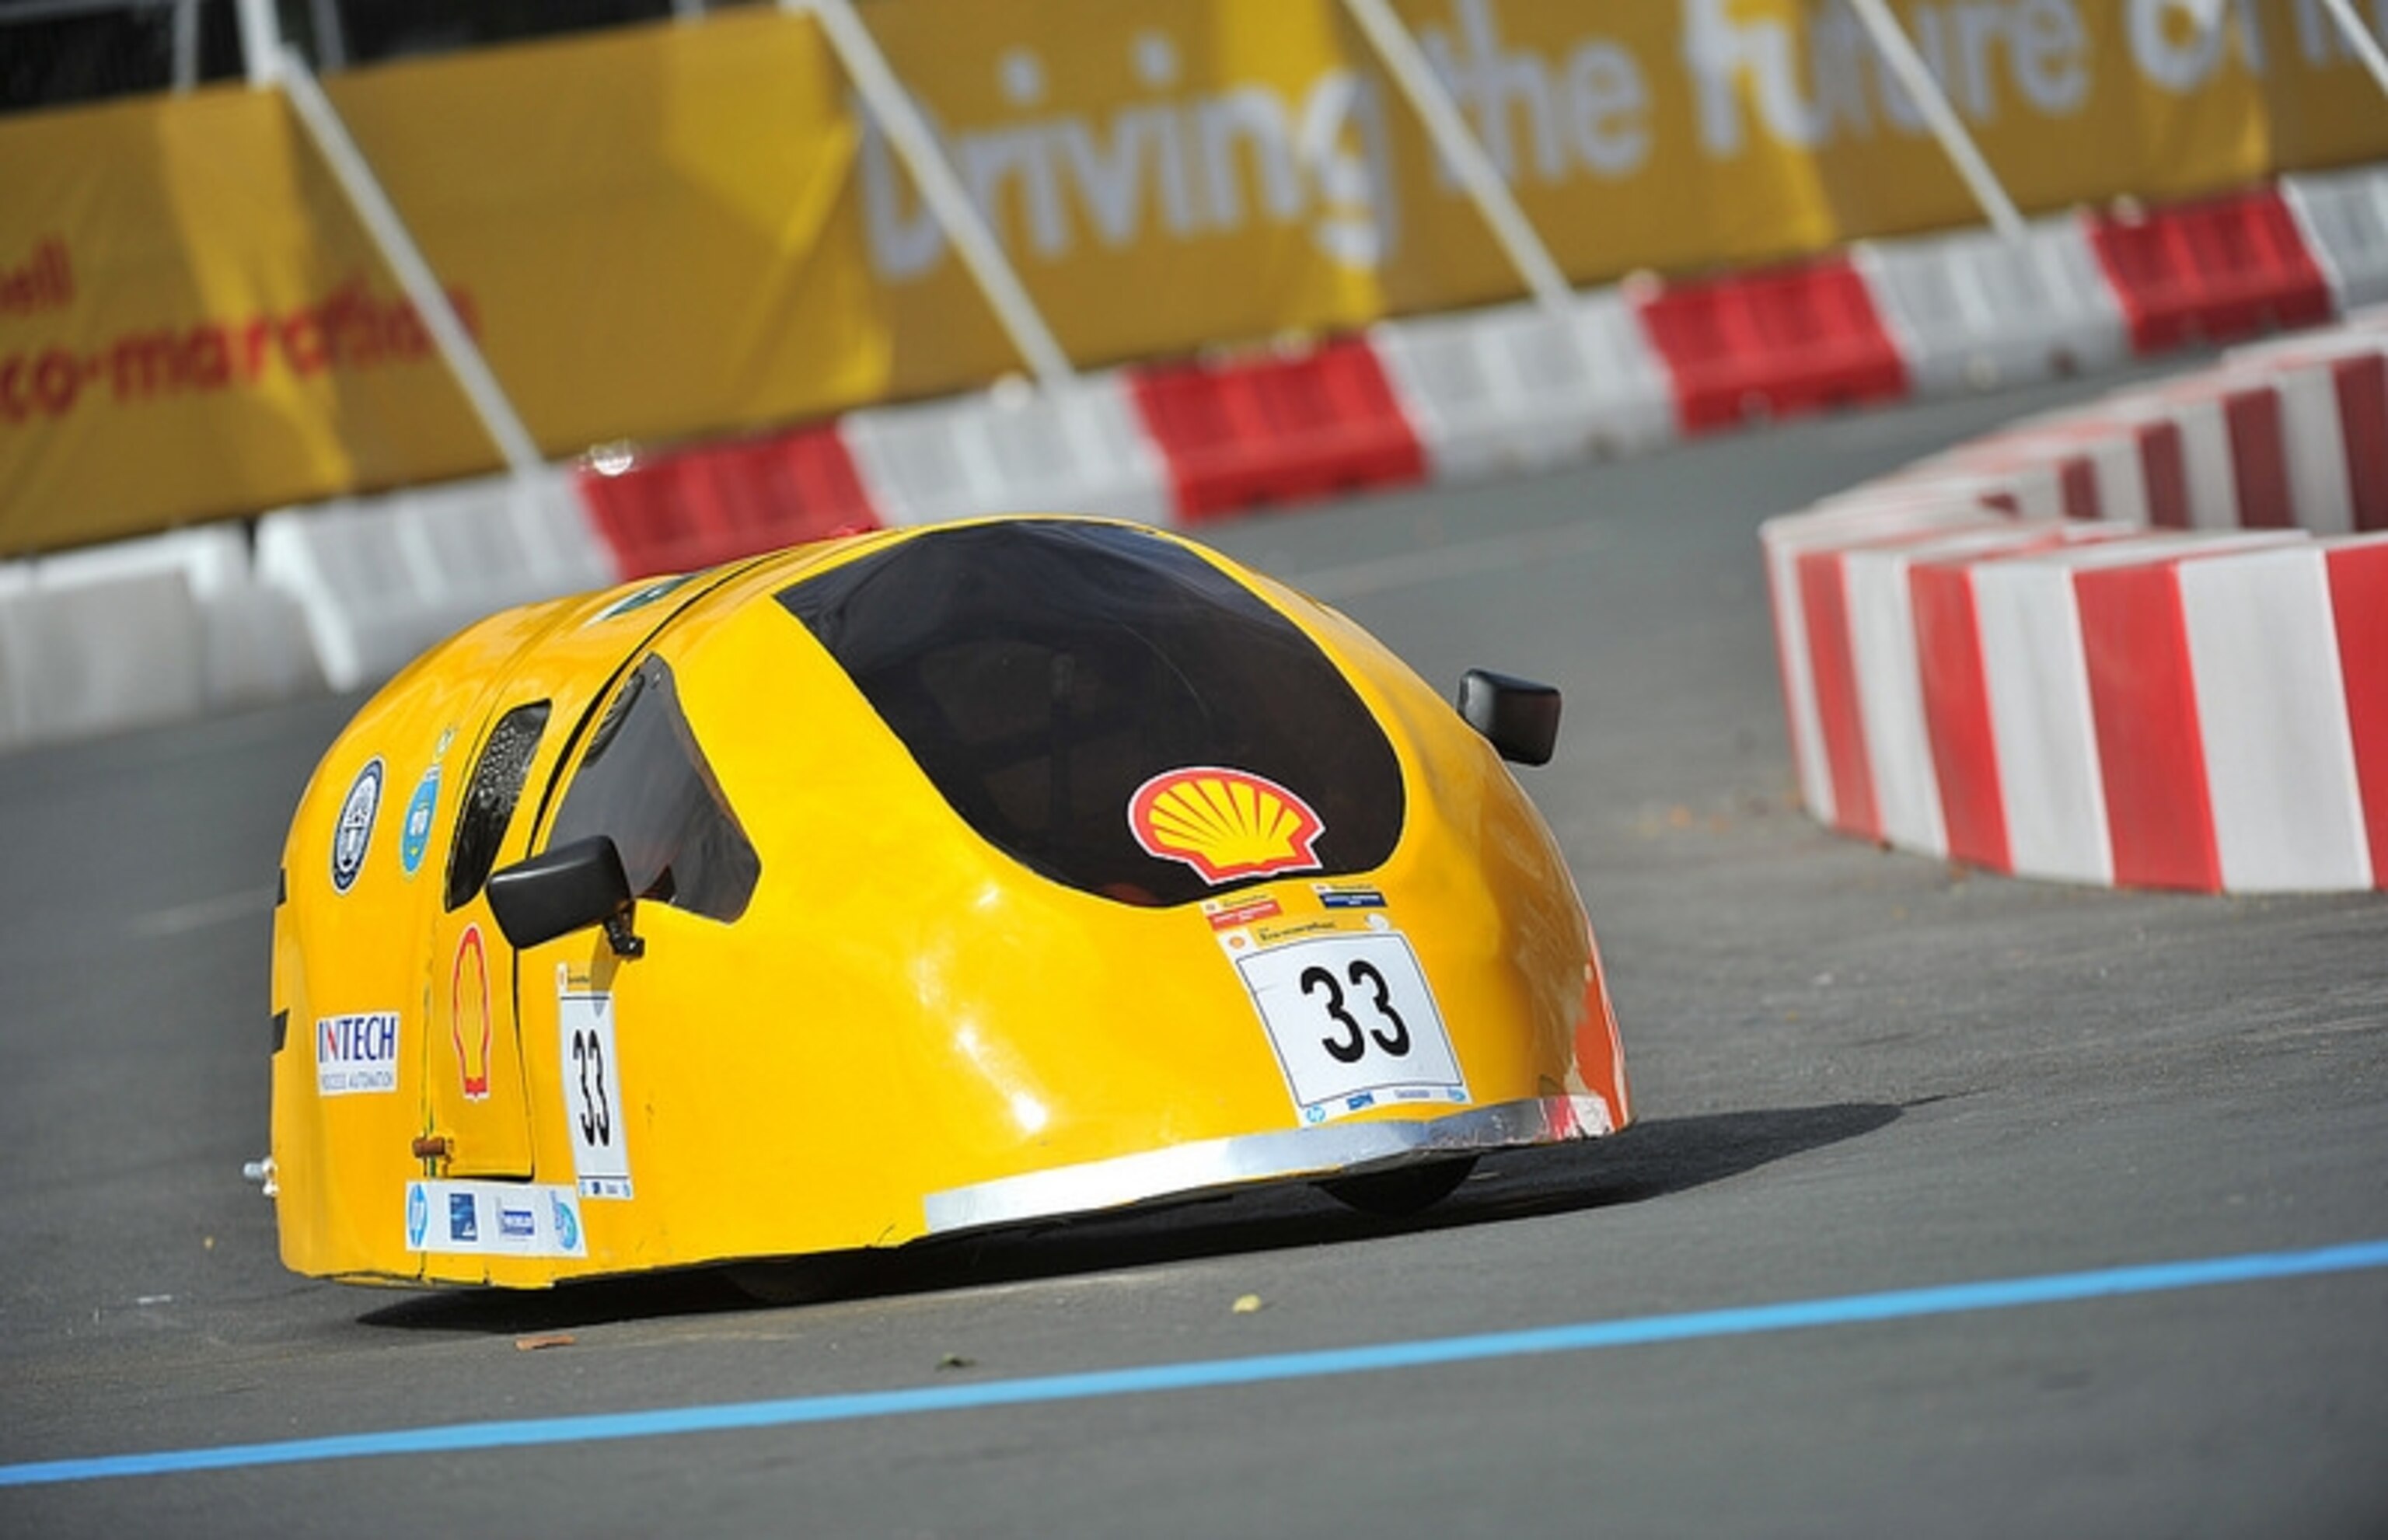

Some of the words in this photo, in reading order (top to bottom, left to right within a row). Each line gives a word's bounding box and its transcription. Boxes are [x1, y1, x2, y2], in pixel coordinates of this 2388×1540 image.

[852, 33, 1397, 284] Driving
[1423, 0, 1651, 189] the
[319, 1016, 395, 1063] INTECH
[1300, 959, 1410, 1063] 33
[573, 1029, 609, 1147] 33
